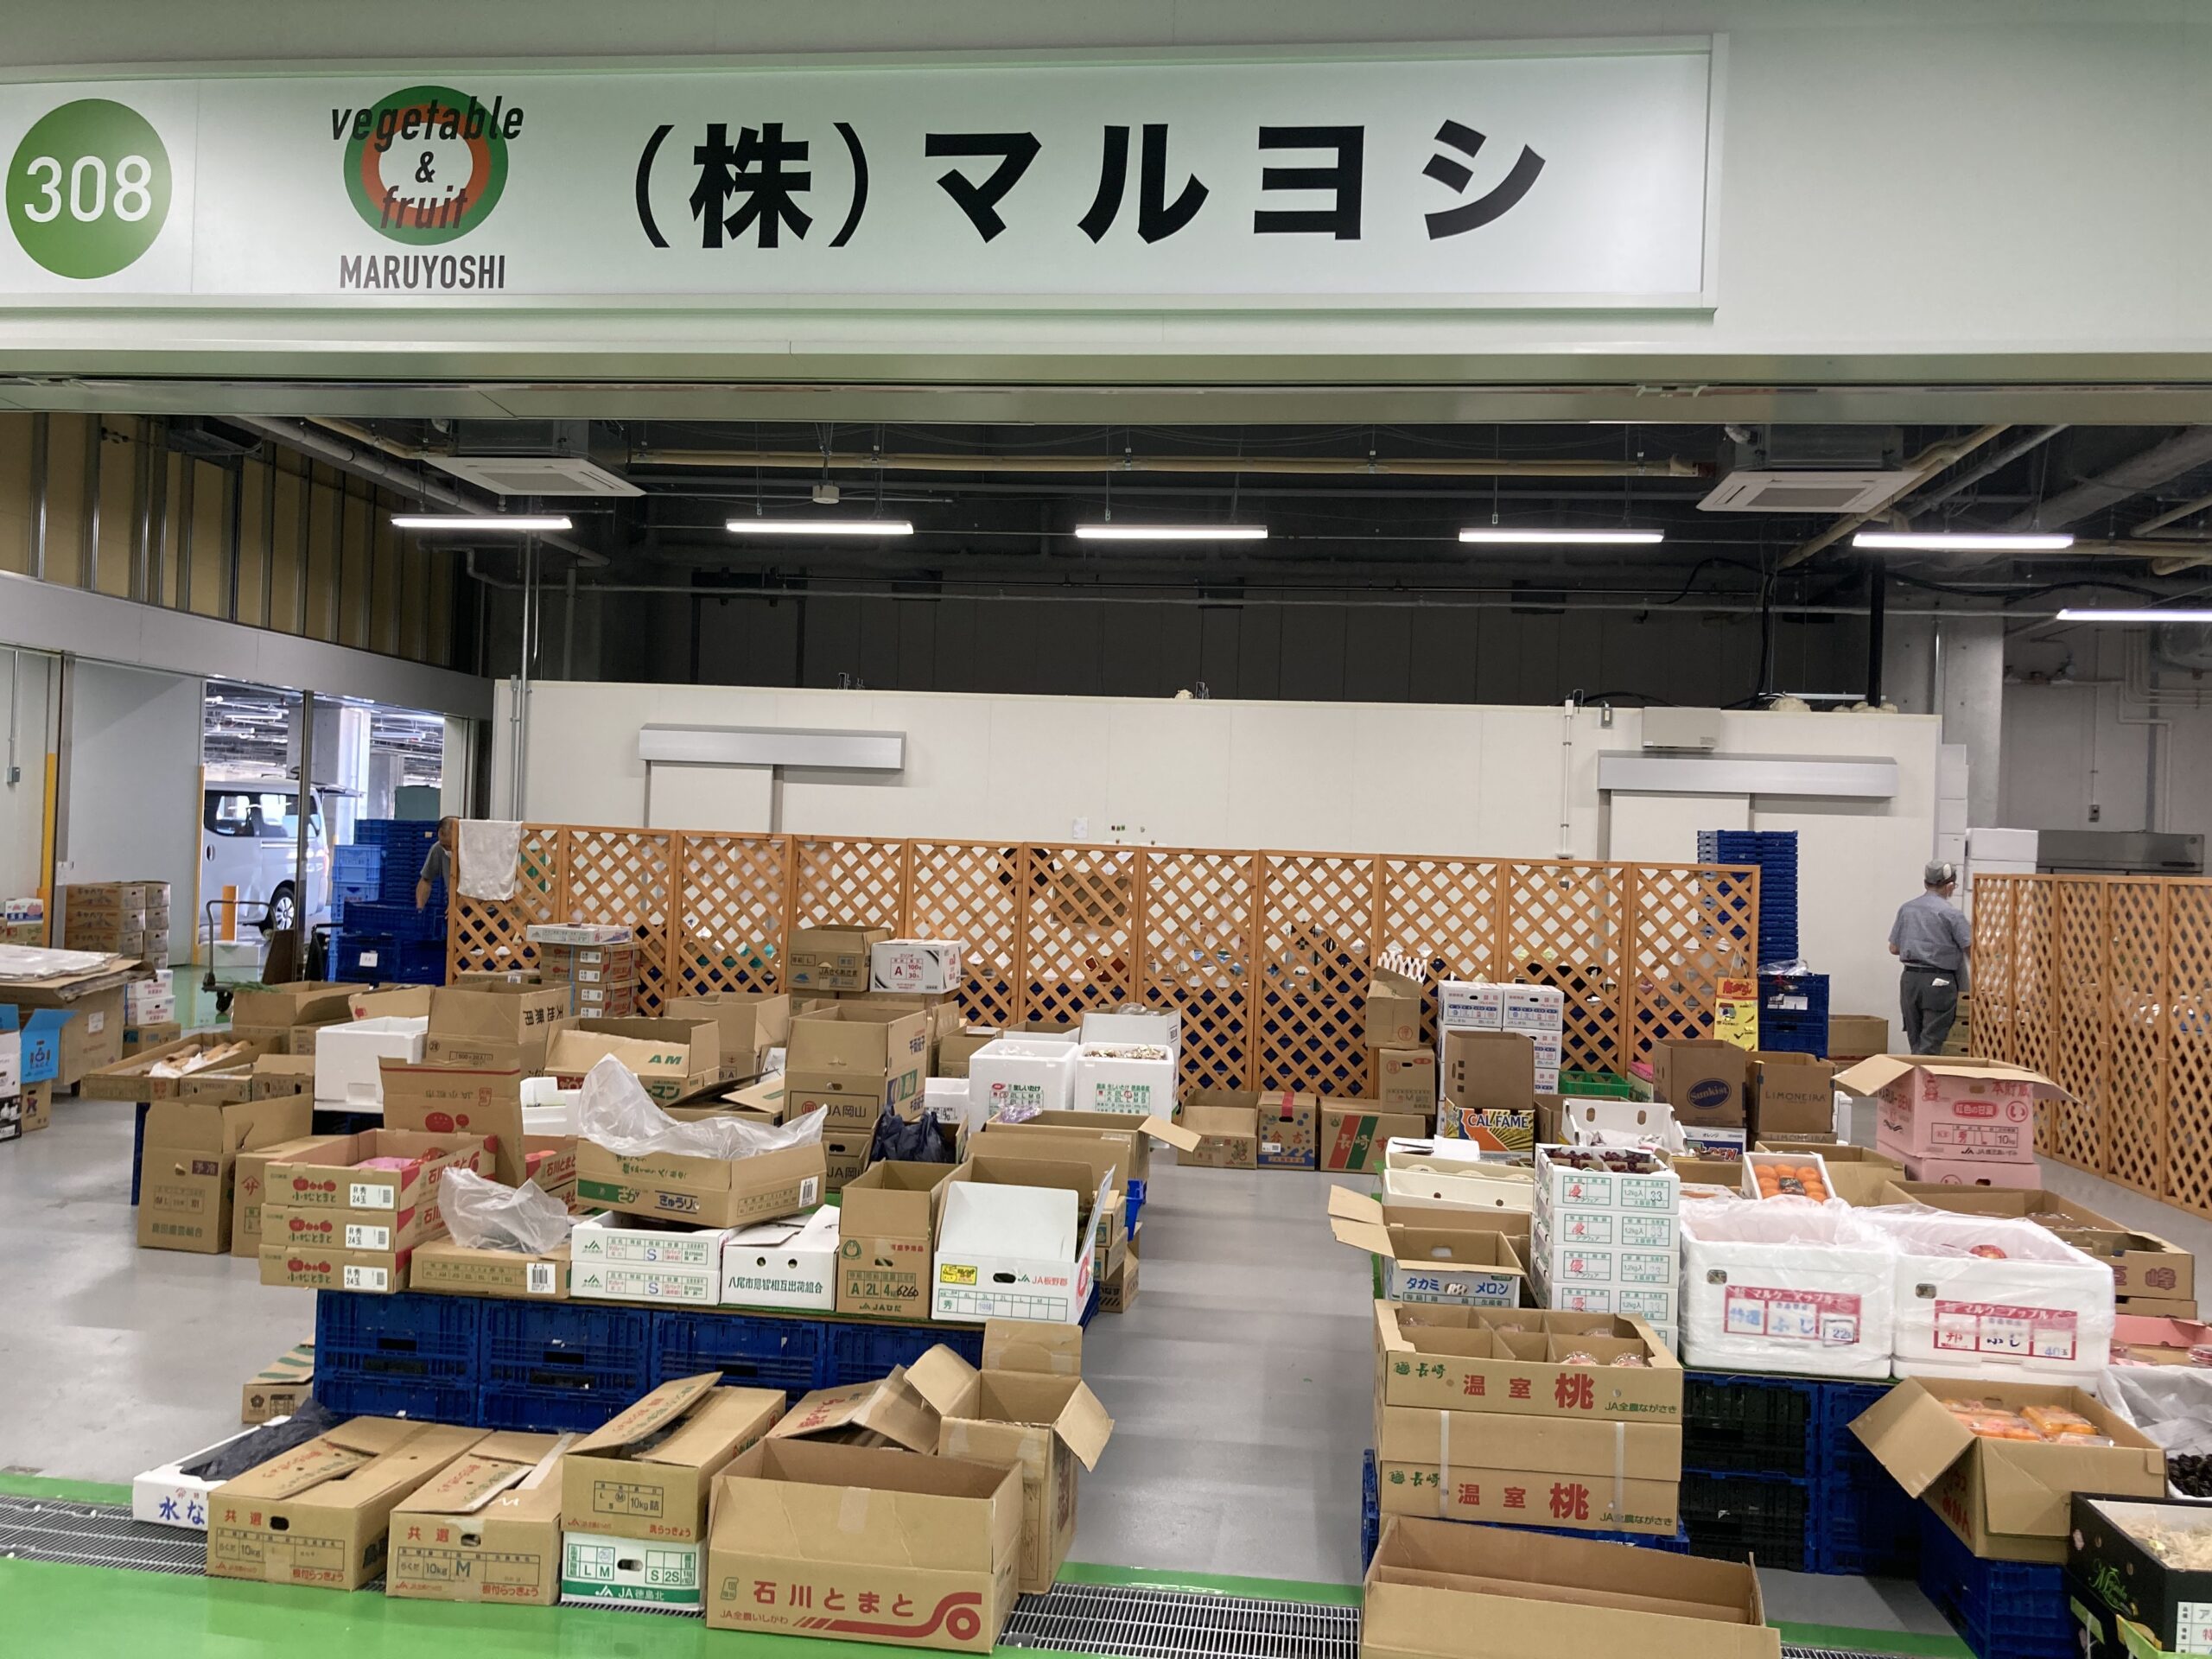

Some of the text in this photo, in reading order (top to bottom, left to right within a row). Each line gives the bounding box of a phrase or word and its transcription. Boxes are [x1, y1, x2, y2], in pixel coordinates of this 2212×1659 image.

[330, 95, 524, 154] vegetable
[414, 150, 436, 183] &
[23, 155, 153, 224] 308
[380, 187, 469, 230] fruit
[339, 255, 505, 289] MARUYOSHI
[894, 966, 902, 976] A
[1690, 1084, 1728, 1103] Sunkist
[1765, 1090, 1826, 1103] LIMONEIRA
[826, 1104, 866, 1117] JA岡山
[1467, 1115, 1529, 1128] CAL FAME
[352, 1195, 367, 1205] 24玉
[659, 1194, 693, 1210] きゅうり
[347, 1236, 362, 1245] 24玉
[646, 1249, 657, 1262] S
[346, 1277, 360, 1287] 24玉
[648, 1282, 658, 1294] S
[851, 1283, 860, 1294] A
[866, 1283, 879, 1295] 2L
[1407, 1277, 1509, 1295] タカミ メロン
[1415, 1362, 1446, 1379] 長崎
[1605, 1402, 1677, 1414] JA全農ながさき
[1410, 1471, 1440, 1488] 長崎
[159, 1497, 205, 1525] 水な
[408, 1526, 449, 1542] 共選
[241, 1544, 261, 1556] 10kg
[426, 1563, 448, 1576] 10kg
[456, 1560, 471, 1578] M
[584, 1565, 680, 1582] L M S 2S
[618, 1587, 664, 1601] JA徳島北
[753, 1580, 913, 1618] 石川とまと
[720, 1609, 788, 1625] JA全農いしかわ
